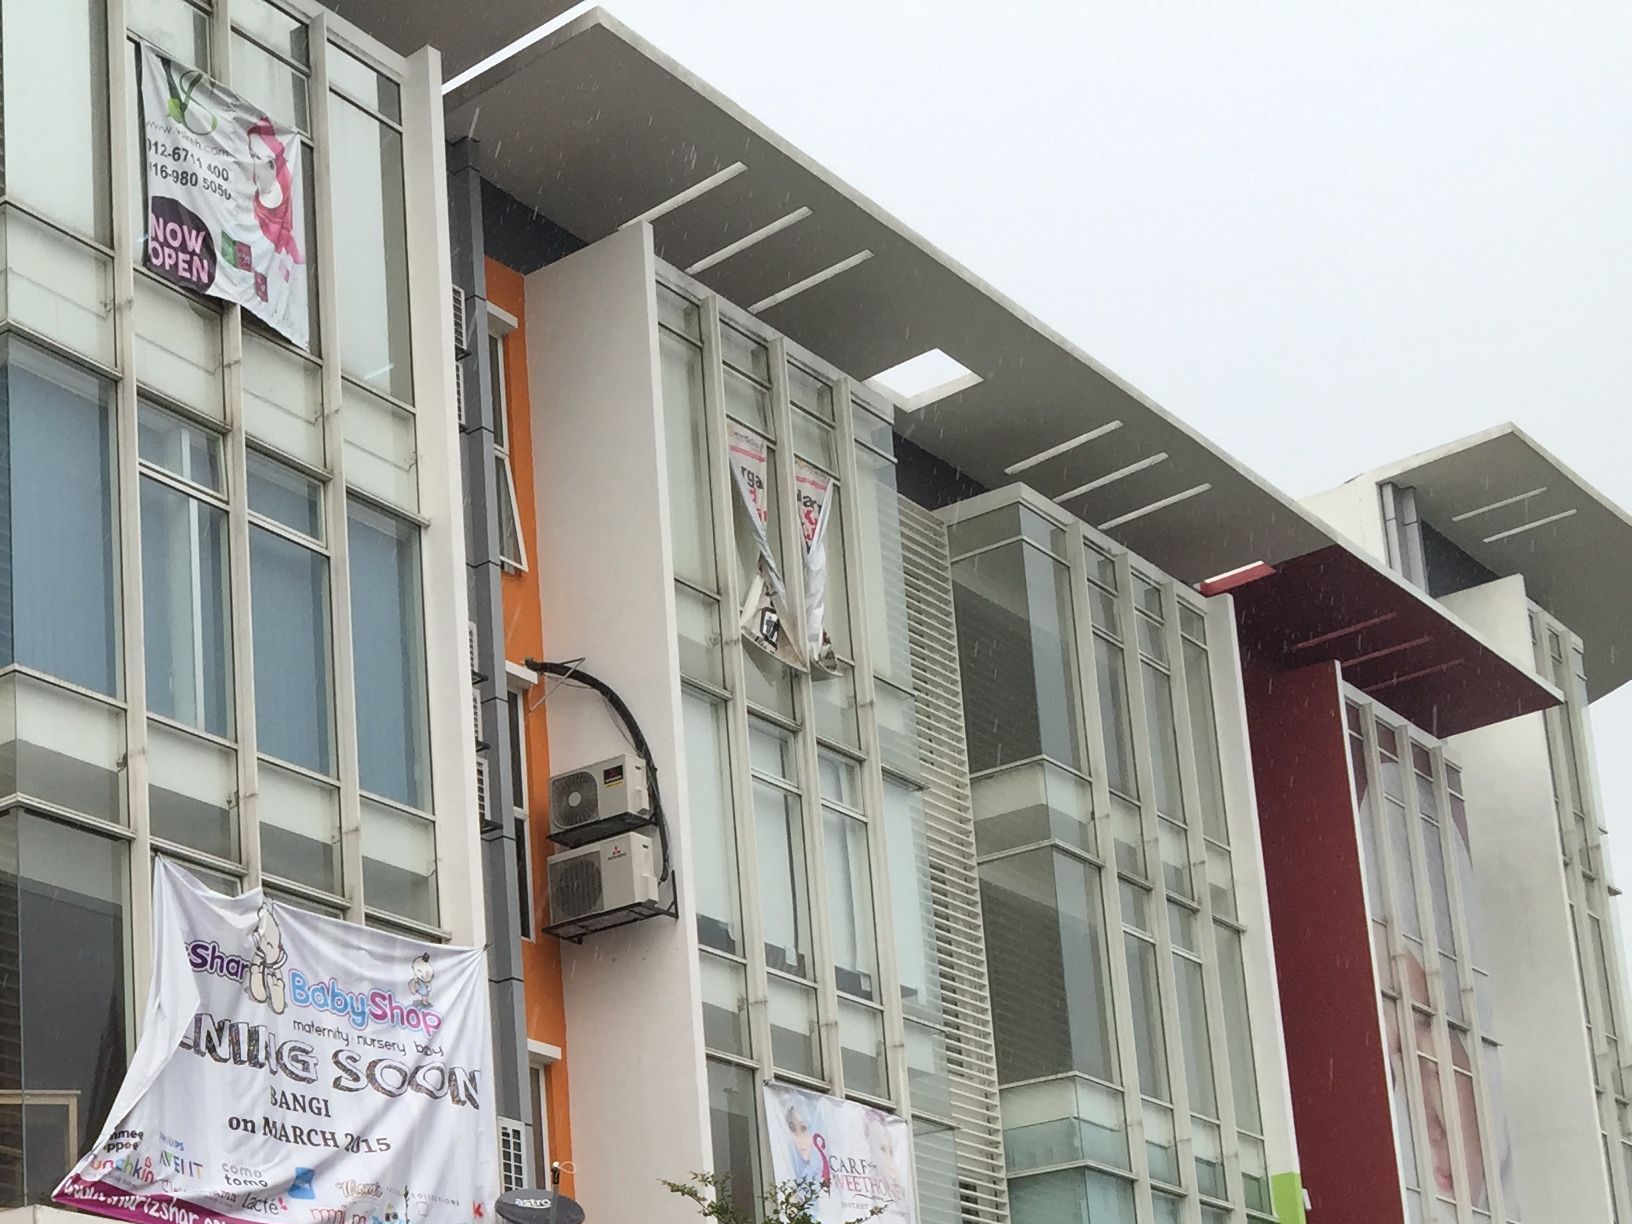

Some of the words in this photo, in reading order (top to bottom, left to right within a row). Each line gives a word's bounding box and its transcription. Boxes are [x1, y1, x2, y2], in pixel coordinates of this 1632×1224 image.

[149, 161, 198, 187] 16-980
[151, 213, 206, 254] NOW
[150, 241, 210, 284] OPEN
[288, 967, 444, 1038] BabyShop
[293, 1019, 350, 1047] maternity
[357, 1034, 406, 1056] nursery
[331, 1049, 481, 1110] SOON
[270, 1086, 331, 1118] BANGI
[228, 1115, 256, 1135] on
[262, 1117, 340, 1149] MARCH
[344, 1133, 391, 1154] 2015
[222, 1162, 263, 1179] como
[224, 1173, 268, 1188] tomo
